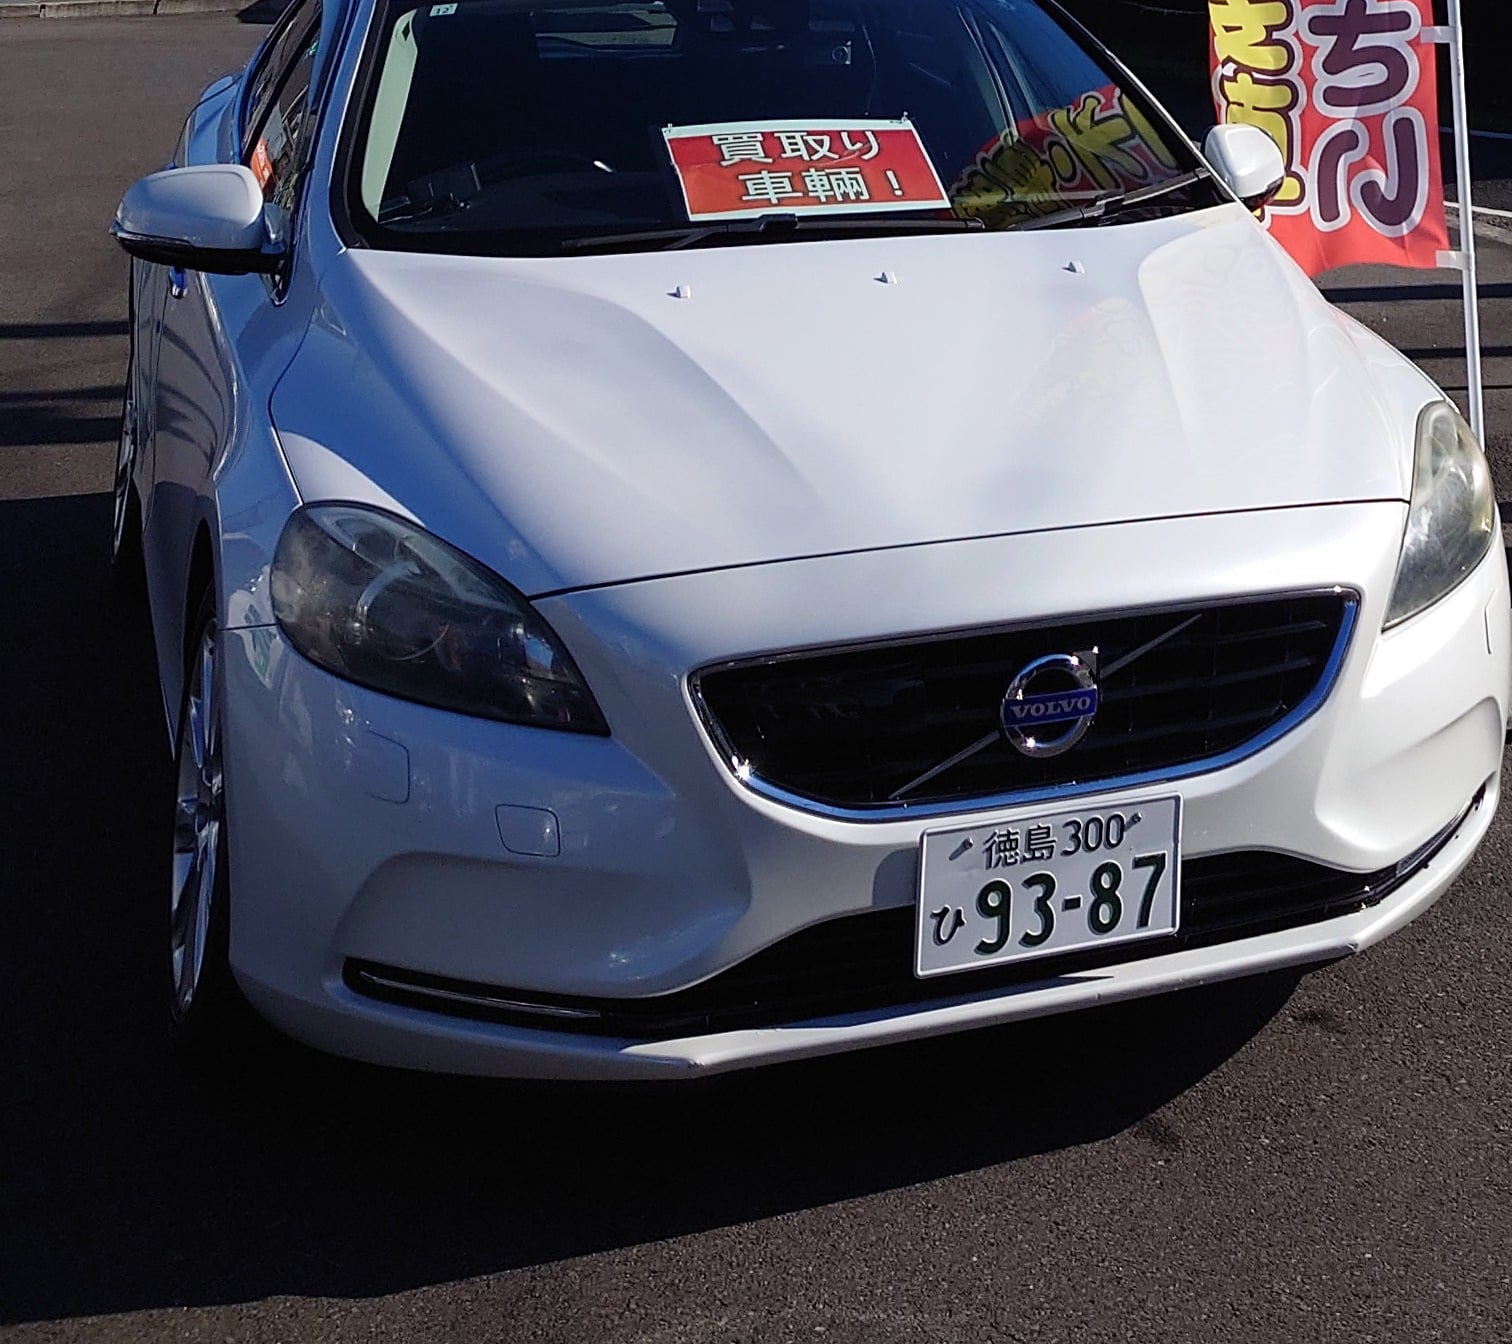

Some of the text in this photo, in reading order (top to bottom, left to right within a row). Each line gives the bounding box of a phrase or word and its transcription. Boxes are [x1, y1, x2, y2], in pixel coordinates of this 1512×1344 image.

[712, 130, 880, 167] 買取り
[1010, 697, 1091, 719] VOLVO
[929, 852, 1167, 956] ひ 93-87
